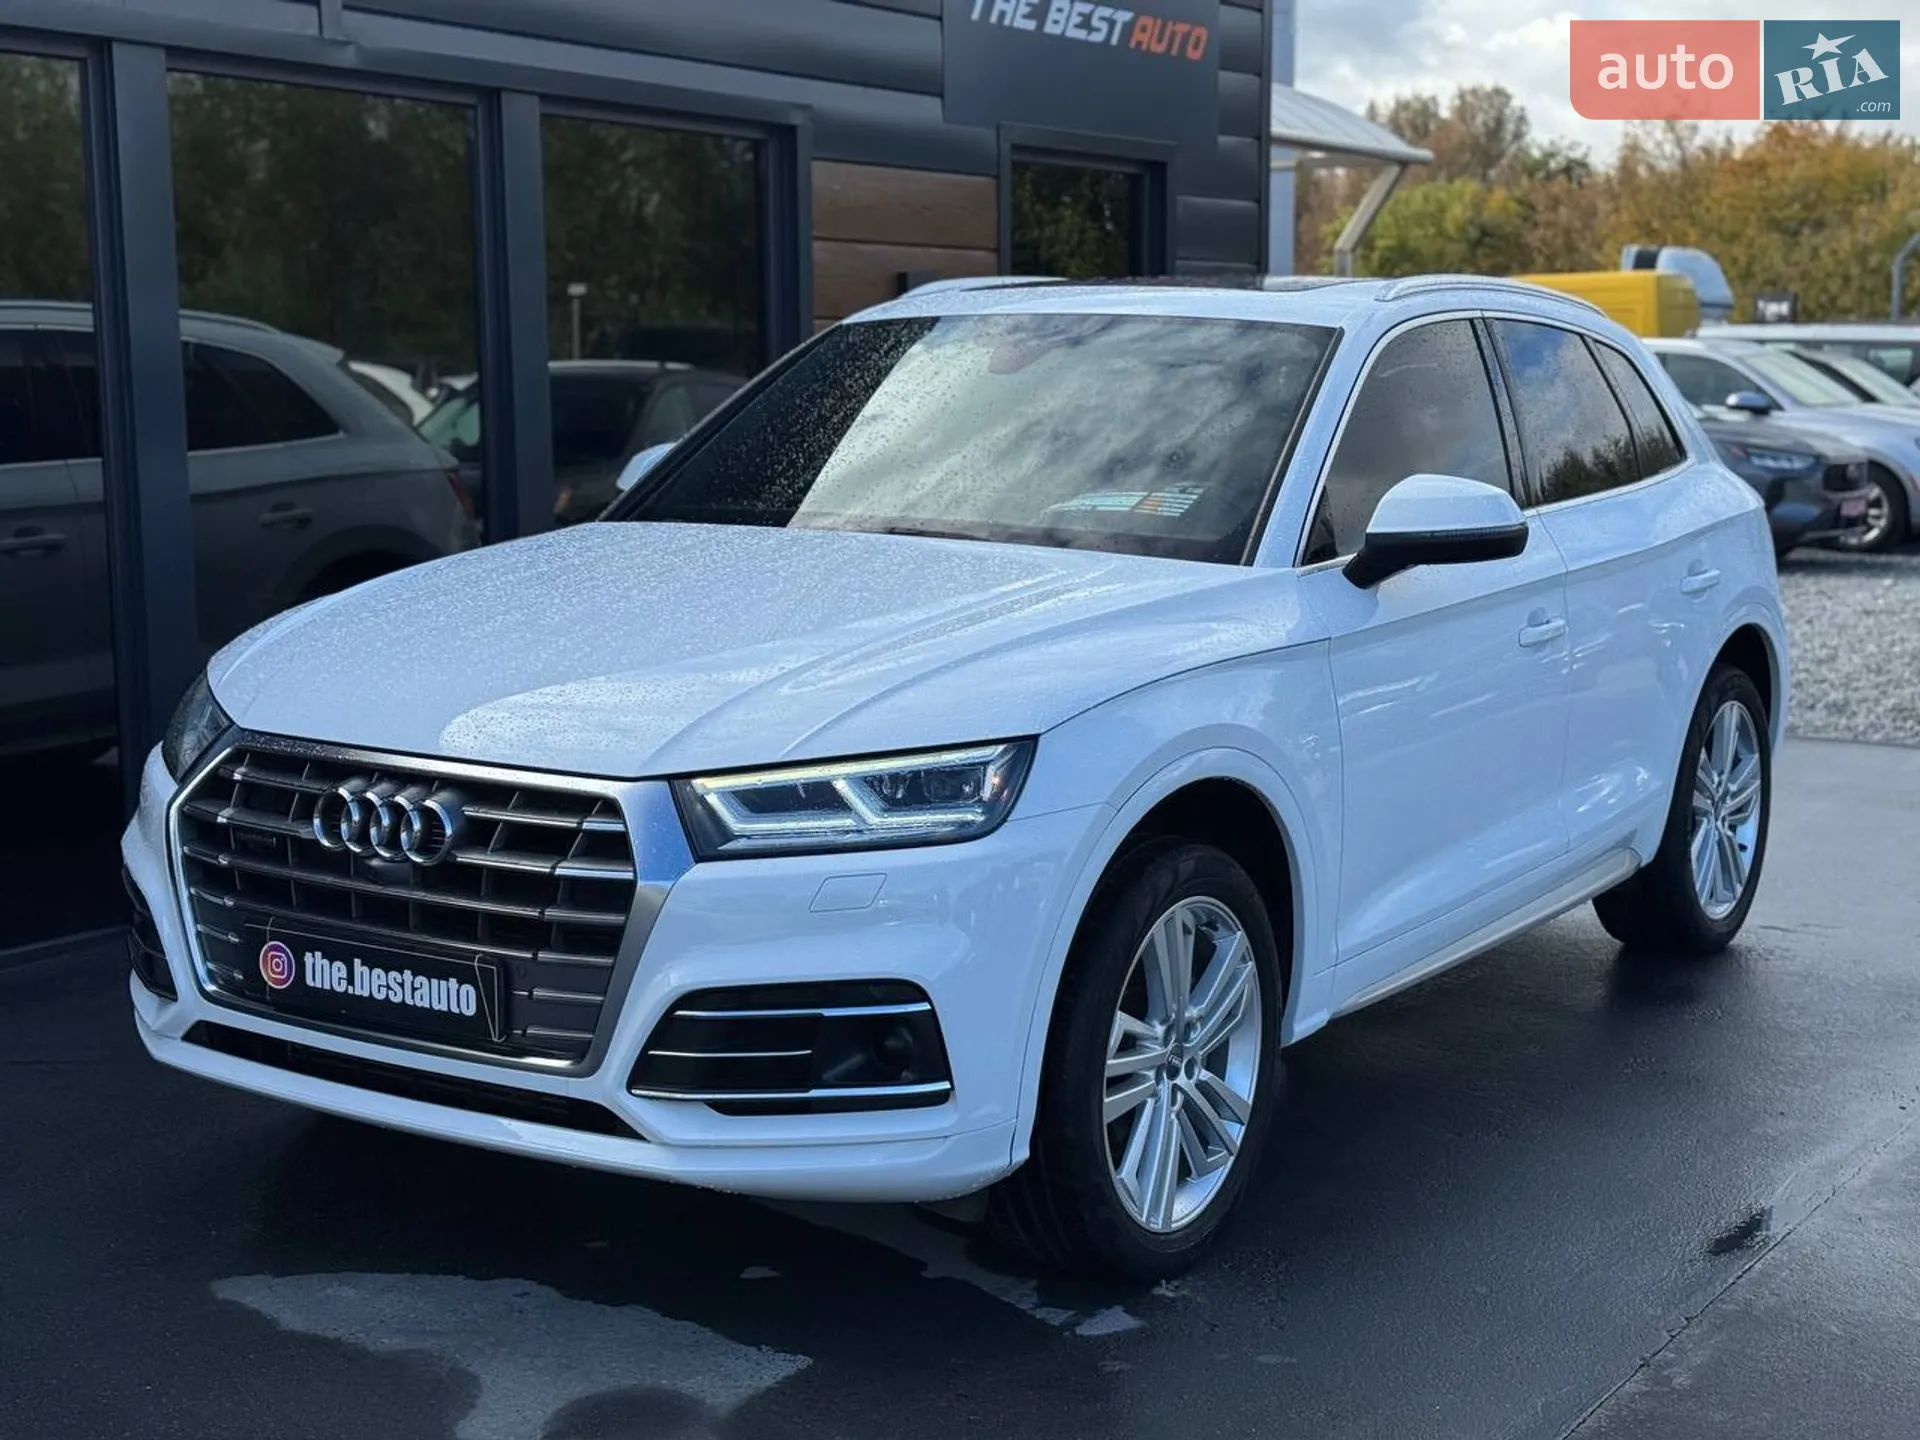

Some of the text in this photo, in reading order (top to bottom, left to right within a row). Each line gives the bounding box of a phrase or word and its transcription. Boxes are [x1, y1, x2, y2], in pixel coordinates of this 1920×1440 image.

[1043, 0, 1135, 45] BEST
[1129, 16, 1208, 60] AUTO
[304, 951, 477, 1016] the.bestauto
